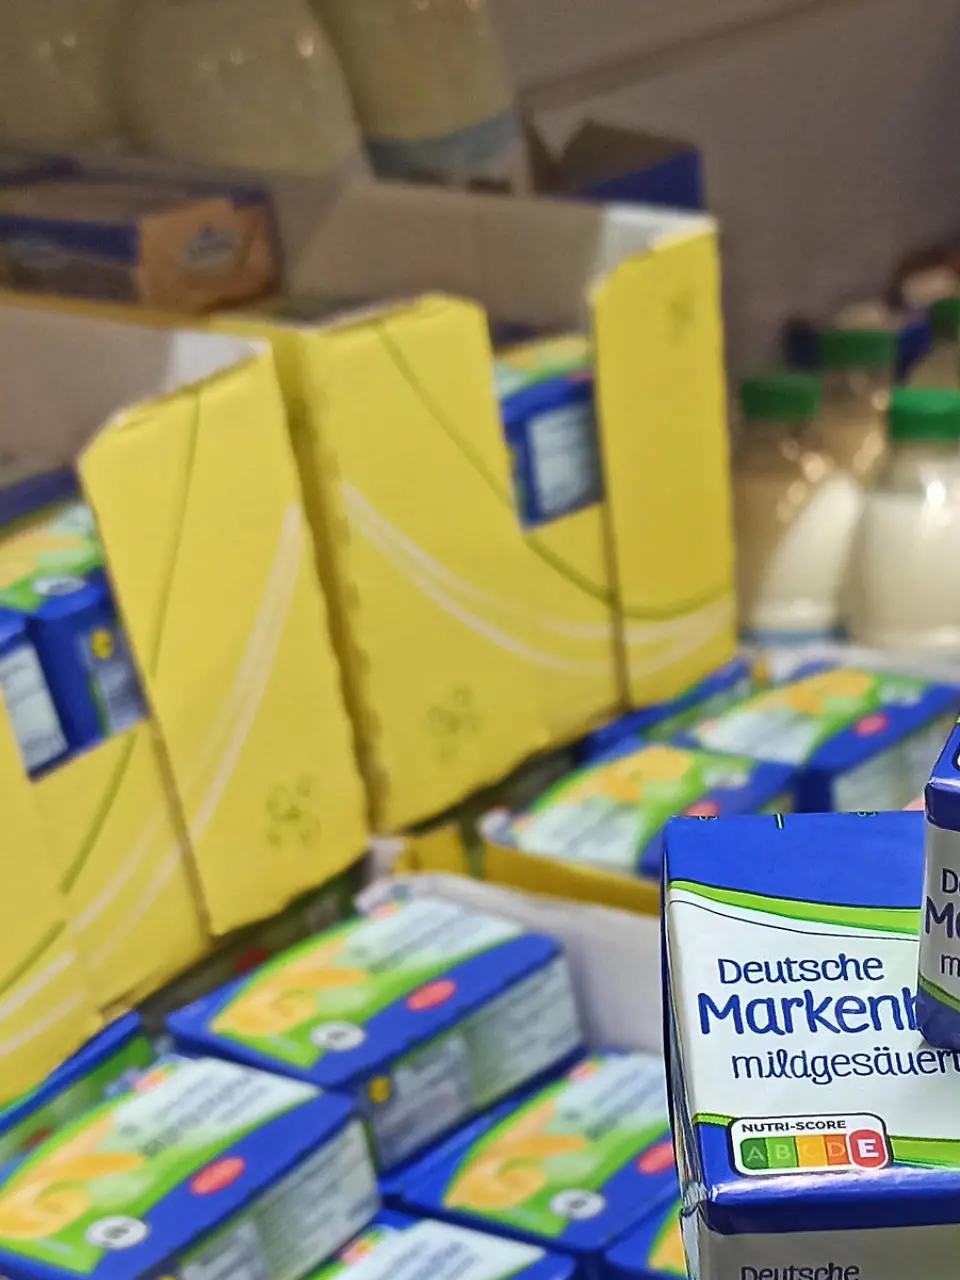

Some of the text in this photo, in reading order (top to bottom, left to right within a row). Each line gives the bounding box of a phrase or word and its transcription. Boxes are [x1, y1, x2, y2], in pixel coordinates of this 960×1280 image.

[718, 953, 885, 984] Deutsche
[742, 1120, 847, 1133] NUTRI-SCORE
[858, 1139, 878, 1158] E
